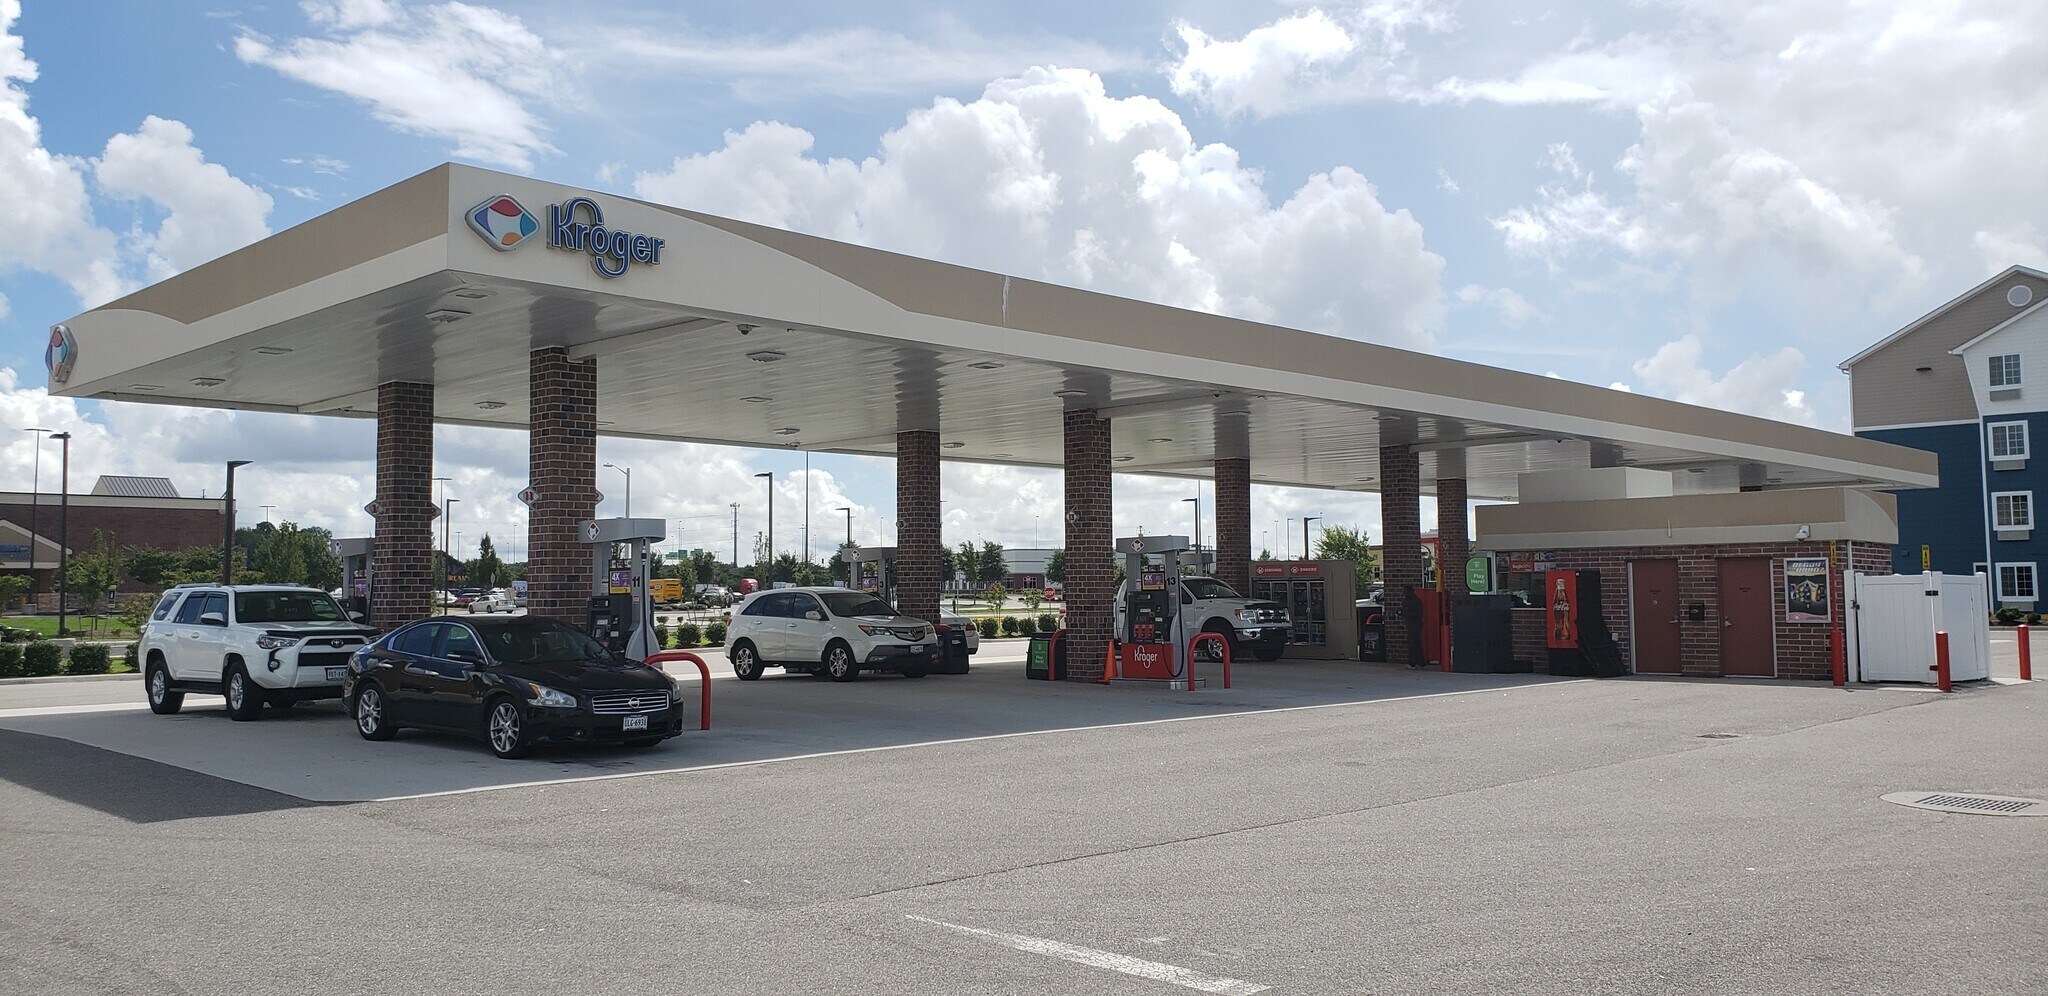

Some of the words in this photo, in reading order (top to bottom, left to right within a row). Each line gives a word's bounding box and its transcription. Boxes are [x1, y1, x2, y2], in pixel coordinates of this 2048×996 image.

[548, 197, 665, 278] Kroger
[612, 572, 620, 581] 4X
[632, 576, 640, 588] 11
[1166, 576, 1176, 586] 13
[1134, 645, 1158, 669] Kroger
